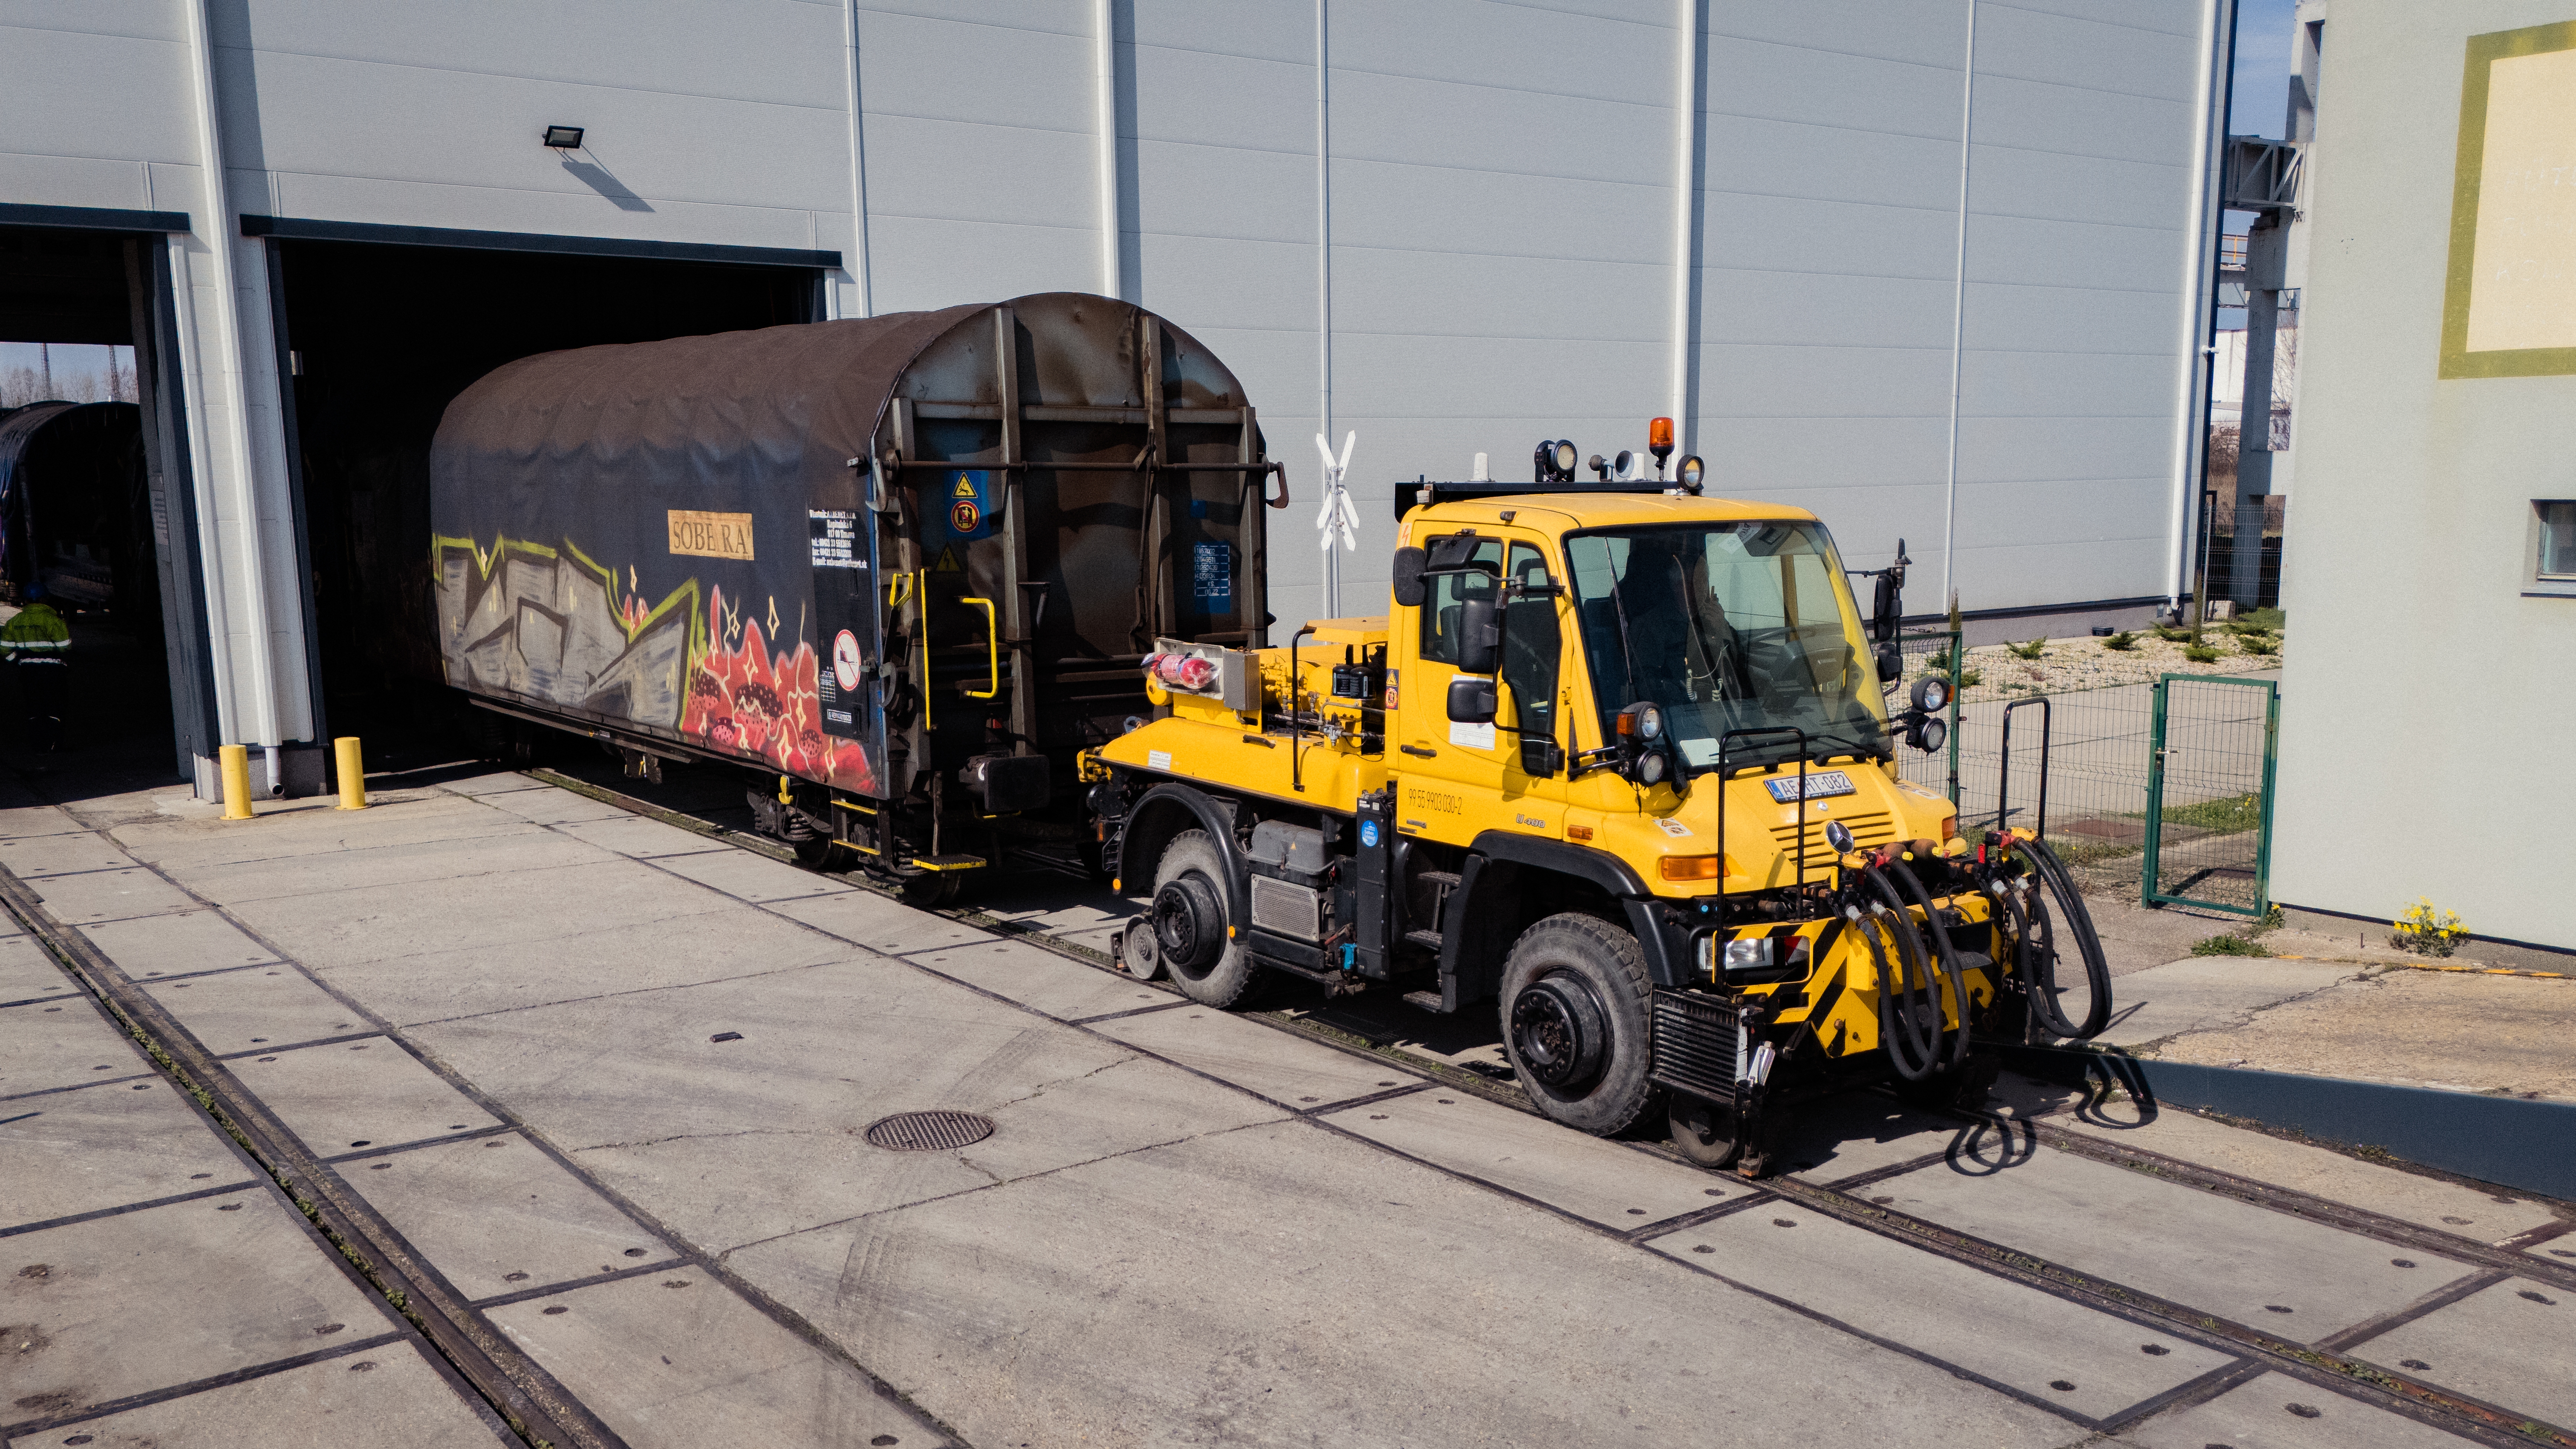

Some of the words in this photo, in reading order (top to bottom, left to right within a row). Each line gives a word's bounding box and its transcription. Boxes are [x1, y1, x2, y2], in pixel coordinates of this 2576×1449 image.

[1779, 780, 1799, 796] AE
[1409, 788, 1416, 806] 99
[1418, 790, 1425, 808] 55
[1426, 791, 1442, 811] 9903
[1443, 794, 1462, 815] 030-2
[1516, 813, 1525, 823] U
[1524, 817, 1546, 828] 400
